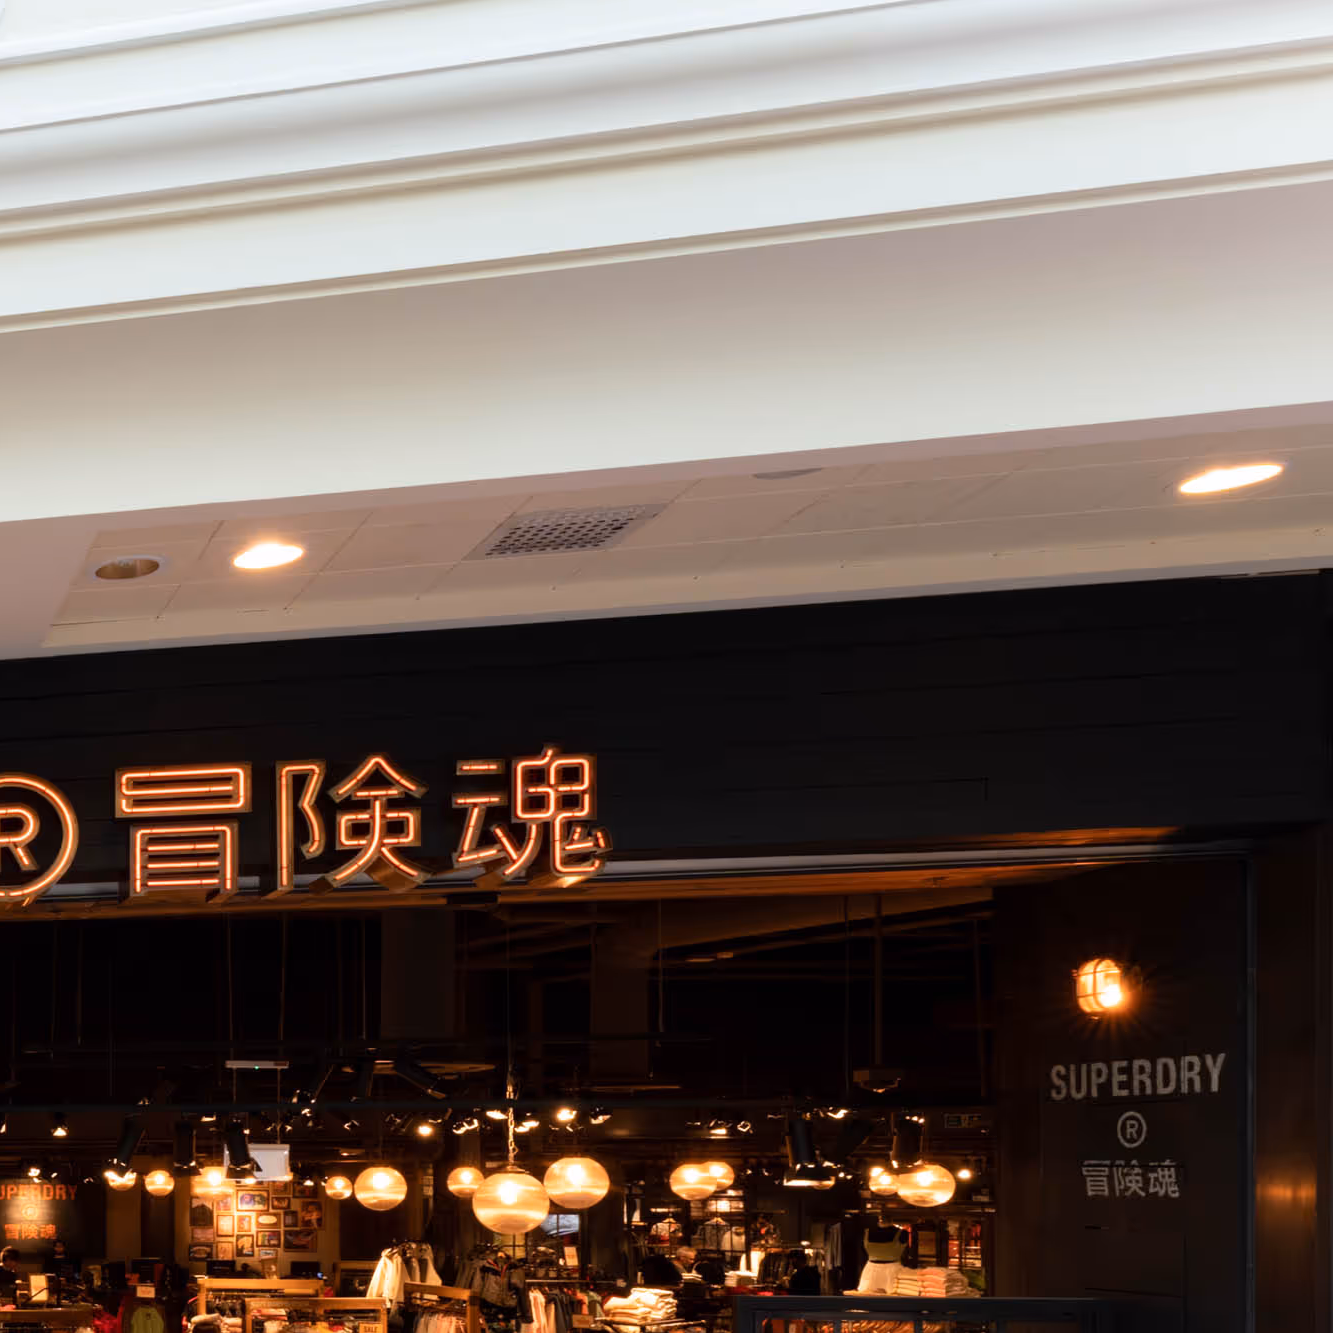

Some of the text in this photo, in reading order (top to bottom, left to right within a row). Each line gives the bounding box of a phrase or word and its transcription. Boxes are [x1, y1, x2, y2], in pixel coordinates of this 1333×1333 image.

[115, 743, 611, 898] 冒険魂
[1050, 1053, 1226, 1101] SUPERDRY
[1082, 1159, 1180, 1198] 冒険魂
